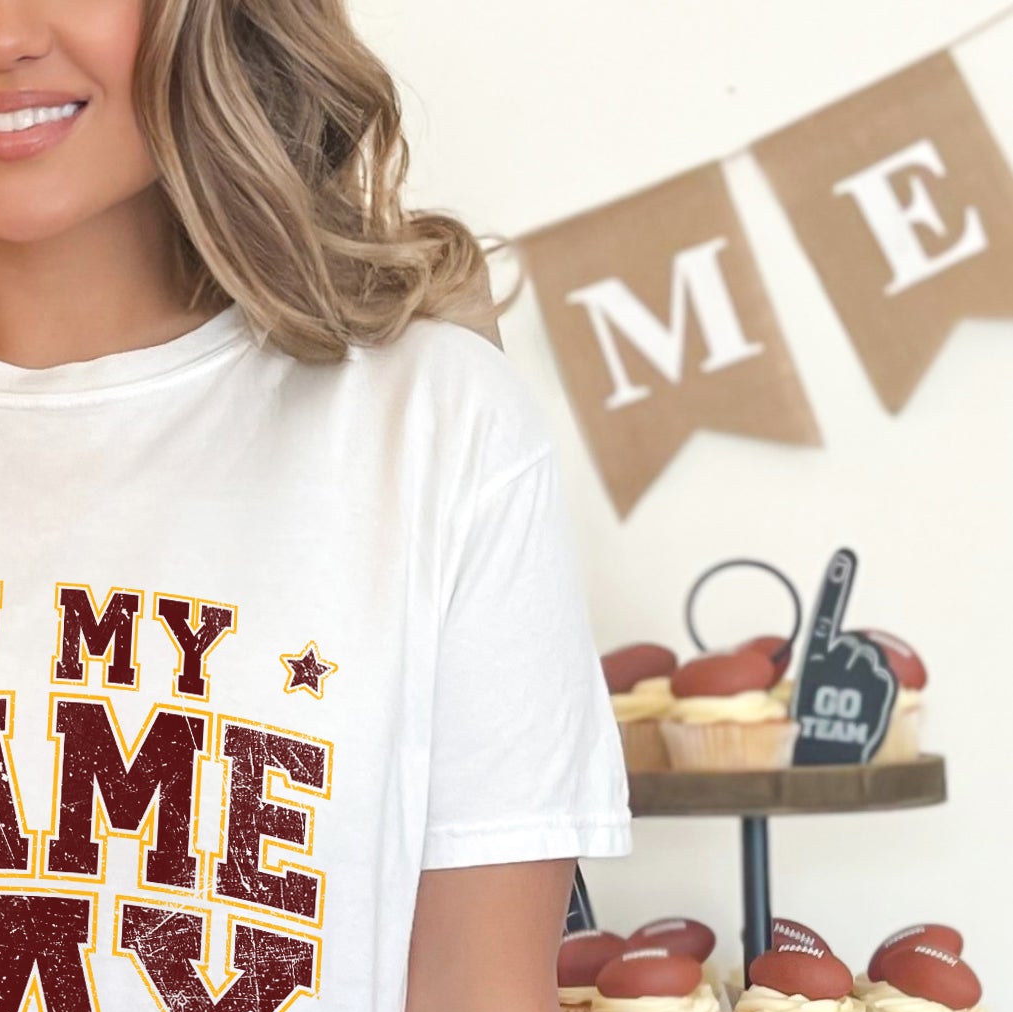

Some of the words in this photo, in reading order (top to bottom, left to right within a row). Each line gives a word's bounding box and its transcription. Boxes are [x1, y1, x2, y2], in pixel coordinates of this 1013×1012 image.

[50, 582, 238, 701] MY
[814, 686, 862, 717] GO
[801, 716, 868, 745] TEAM
